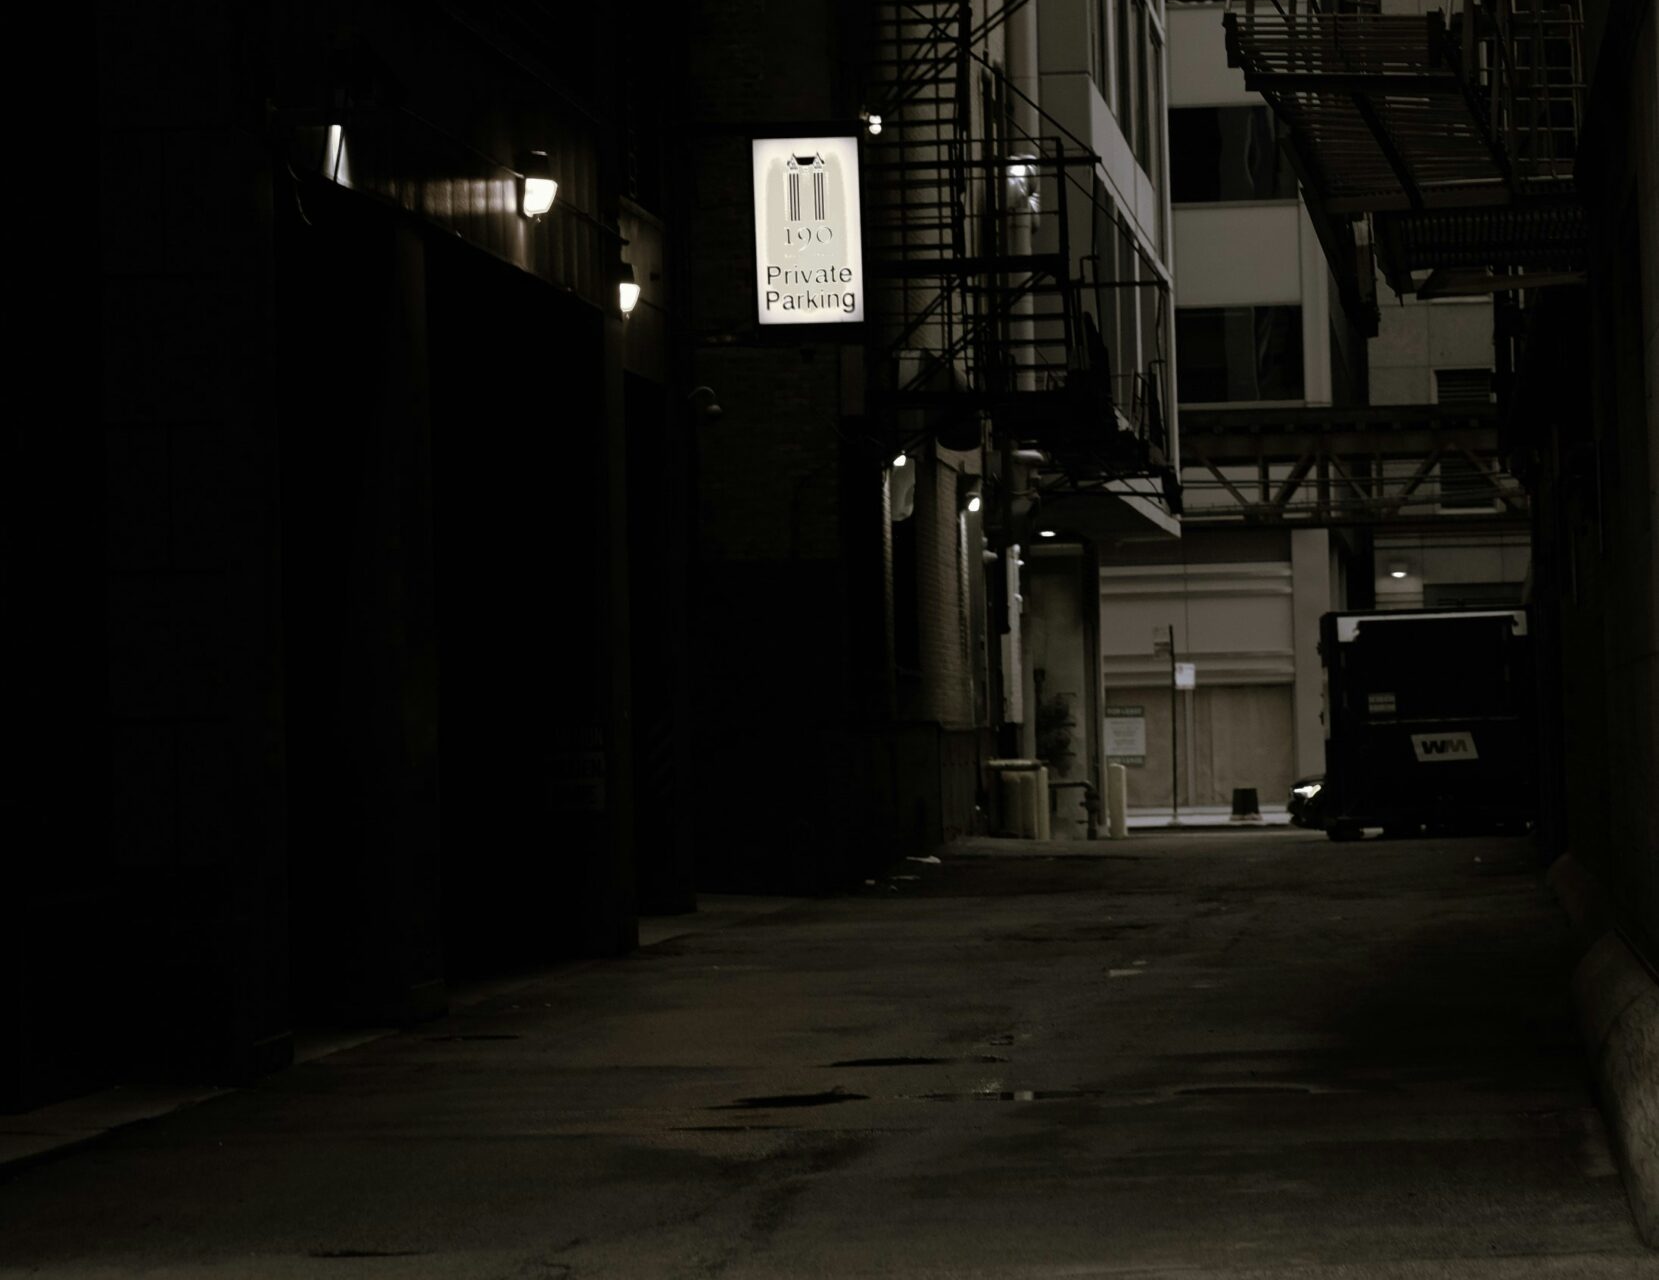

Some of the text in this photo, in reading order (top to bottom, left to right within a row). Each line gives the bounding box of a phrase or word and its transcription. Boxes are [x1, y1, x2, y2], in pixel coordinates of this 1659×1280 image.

[784, 225, 833, 251] 190
[767, 265, 852, 285] Private
[766, 289, 855, 313] Parking
[1421, 739, 1468, 755] WM
